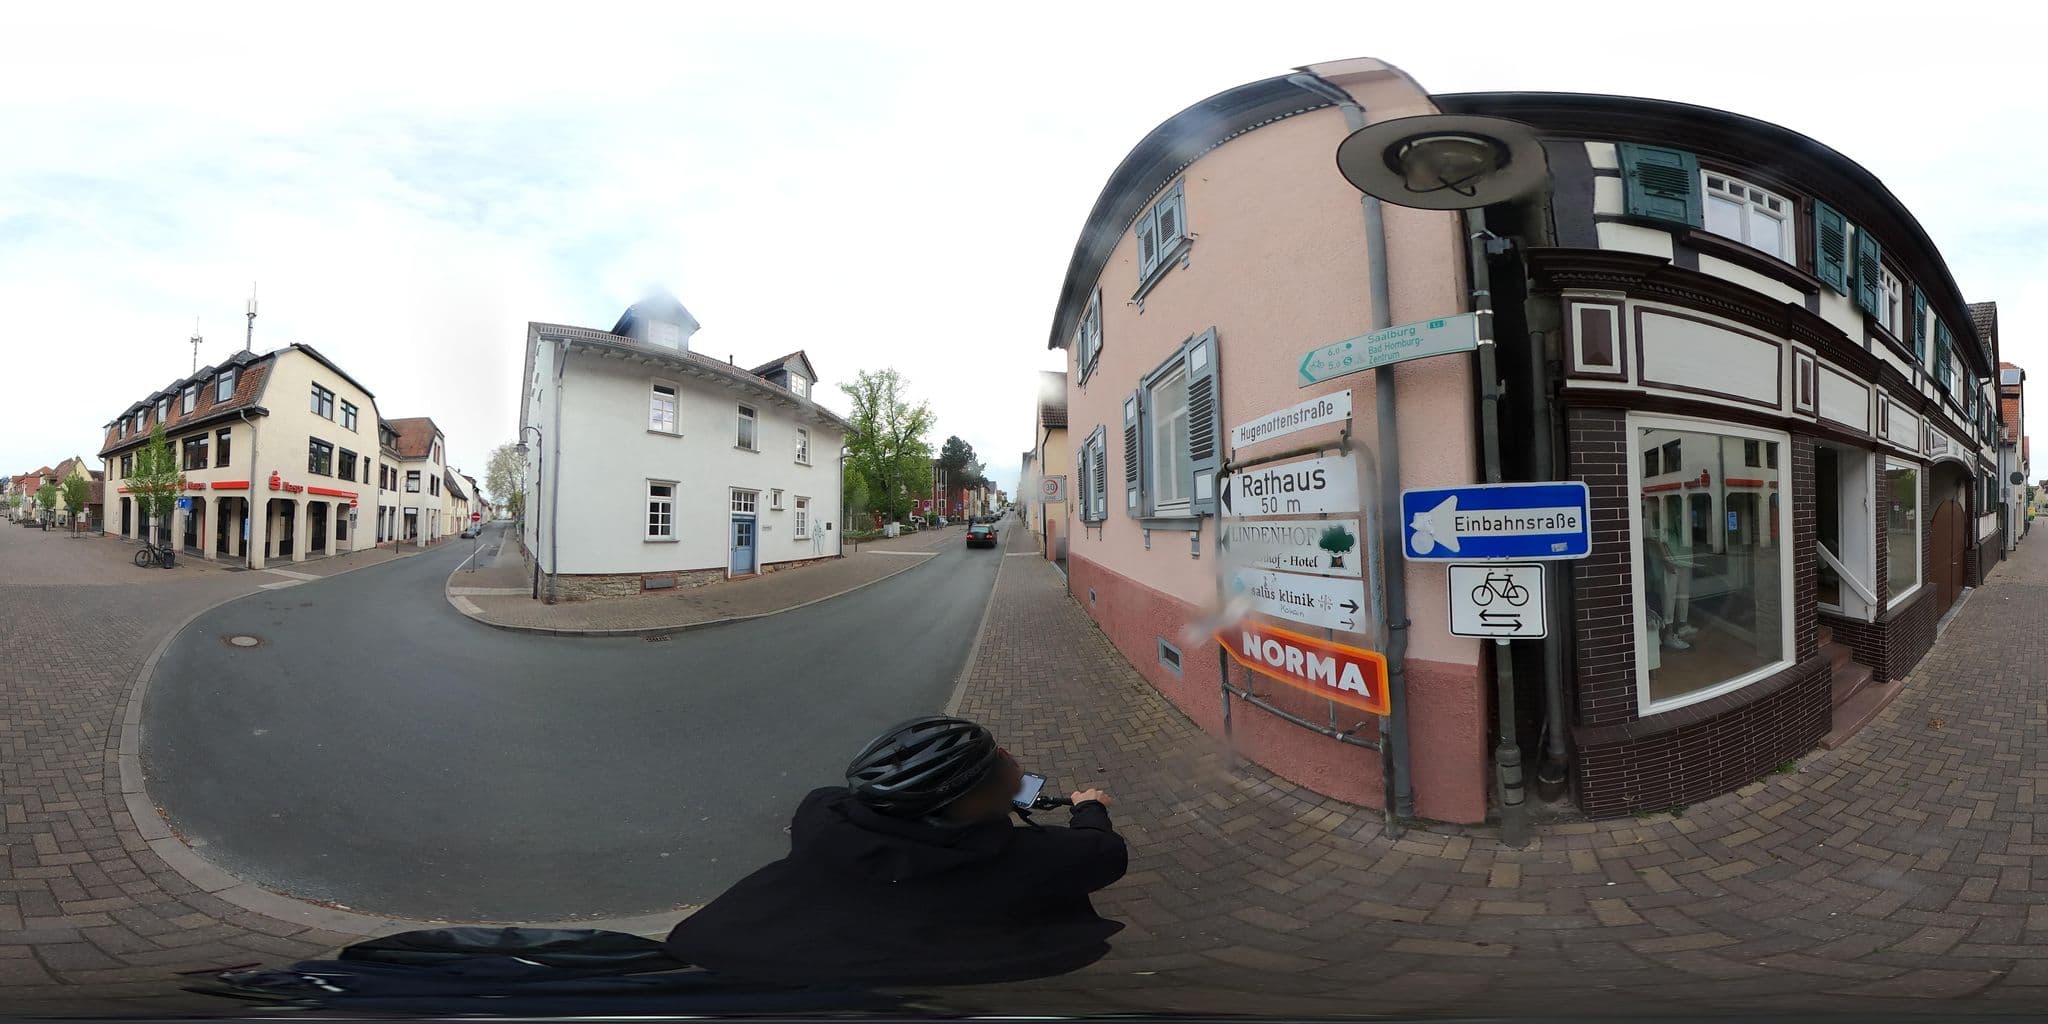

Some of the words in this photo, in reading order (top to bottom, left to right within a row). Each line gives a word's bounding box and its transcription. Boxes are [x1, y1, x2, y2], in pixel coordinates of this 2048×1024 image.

[1368, 327, 1416, 344] Saalburg
[1368, 344, 1382, 355] Bad
[1385, 336, 1424, 351] Homburg-
[1368, 351, 1400, 365] Zentrum
[1241, 401, 1333, 441] Hugenottenstraße
[1242, 469, 1326, 498] Rathaus
[1262, 497, 1278, 514] 50
[1287, 498, 1301, 512] m
[1455, 513, 1577, 532] Einbahnsraße
[1231, 526, 1317, 546] LINDENHOF
[1290, 555, 1318, 568] Hotel
[1251, 585, 1276, 600] salus
[1279, 589, 1315, 608] klinik
[1242, 631, 1371, 698] NORMA
